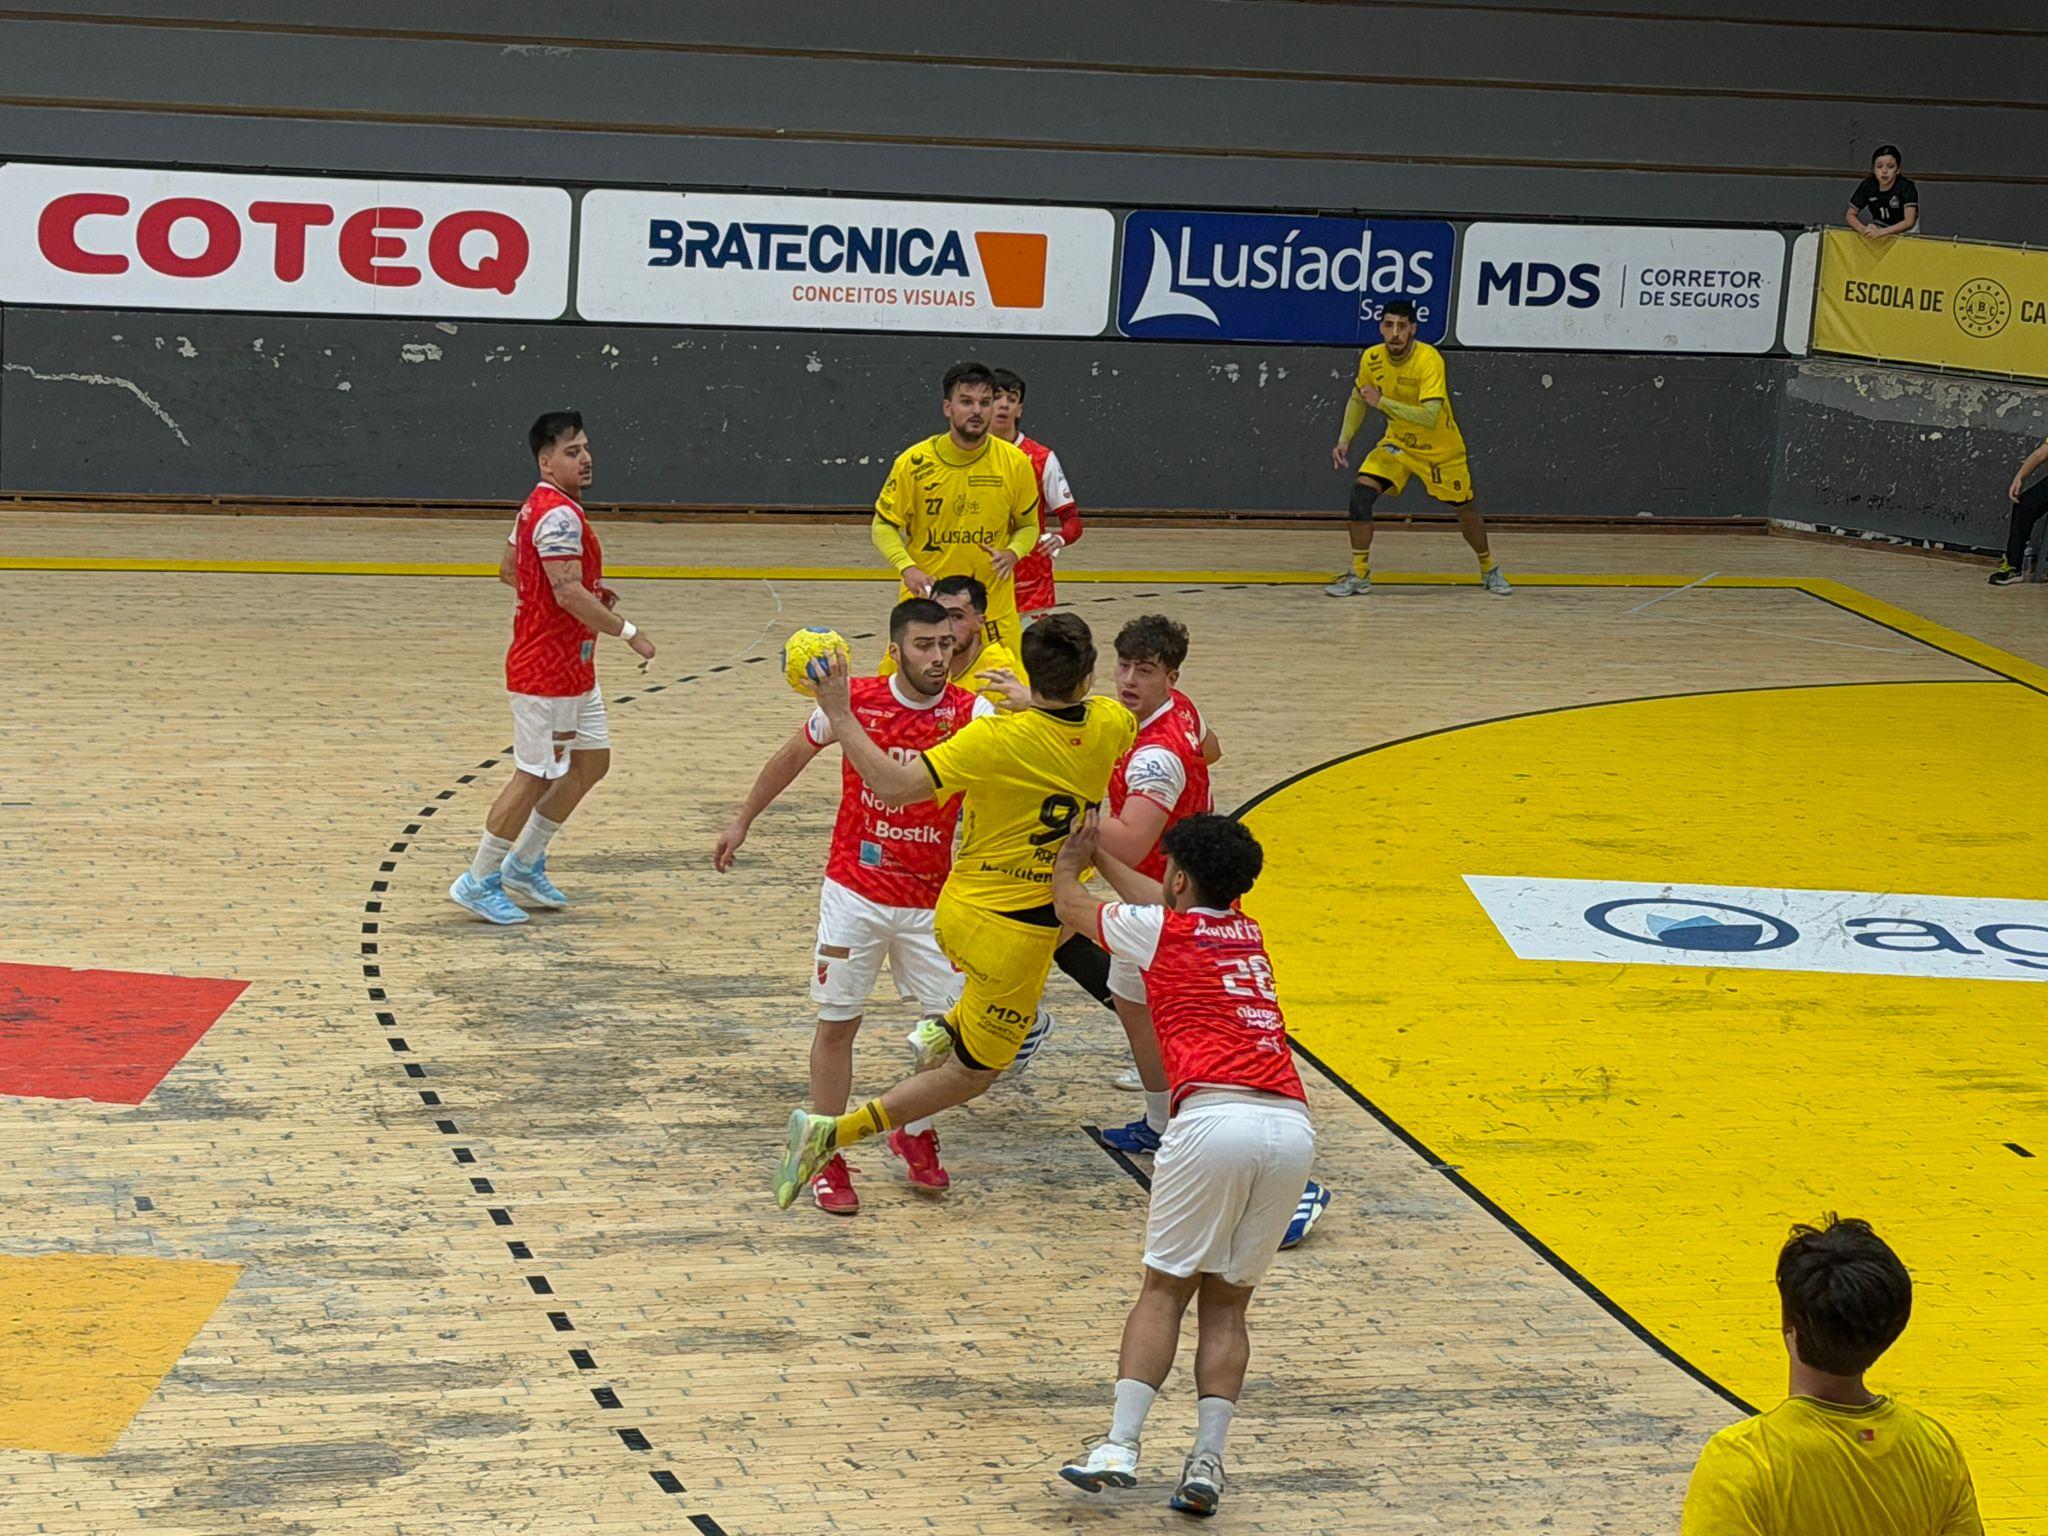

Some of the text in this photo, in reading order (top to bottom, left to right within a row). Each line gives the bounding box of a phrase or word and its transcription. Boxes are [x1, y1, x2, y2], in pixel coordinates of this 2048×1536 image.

[38, 192, 530, 295] COTEQ
[648, 218, 969, 277] BRATECNICA
[1179, 226, 1433, 295] Lusíadas
[1477, 260, 1600, 309] MDS
[1639, 267, 1763, 291] CORRETOR
[792, 285, 976, 308] CONCEITOS VISUAIS
[1639, 289, 1762, 310] DE SEGUROS
[1844, 280, 1914, 311] ESCOLA
[1919, 288, 1944, 313] DE
[1360, 298, 1430, 322] Sae
[925, 498, 944, 516] 27
[875, 820, 942, 844] Bostik
